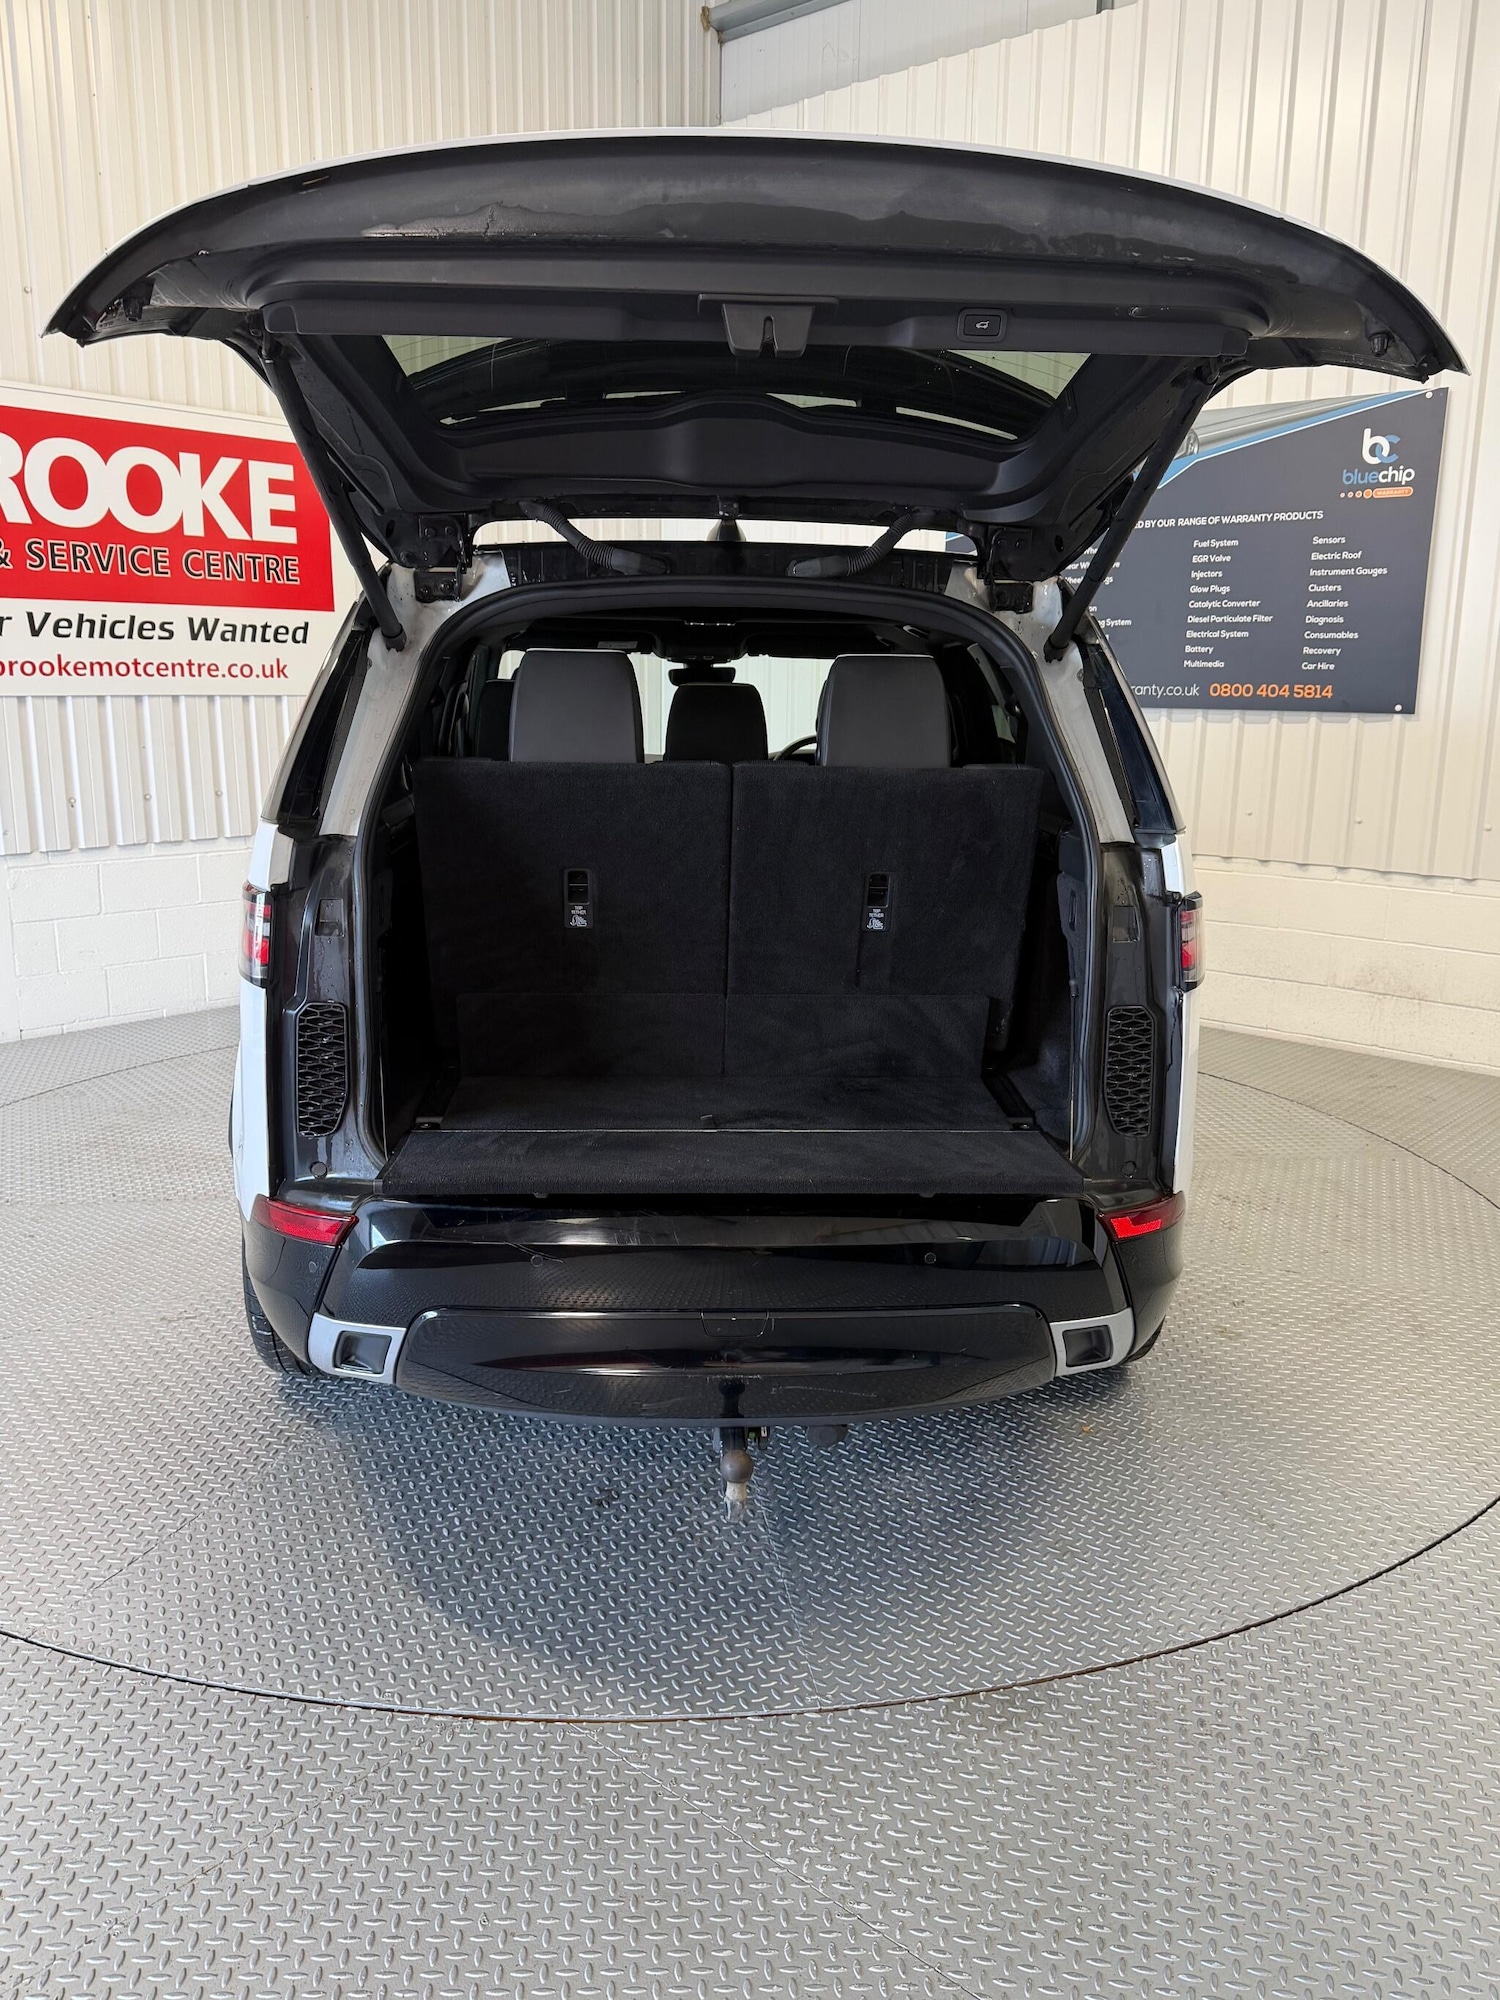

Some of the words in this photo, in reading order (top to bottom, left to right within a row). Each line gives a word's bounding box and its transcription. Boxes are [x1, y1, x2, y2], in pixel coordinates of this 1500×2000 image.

[1342, 465, 1415, 485] bluechip
[1145, 519, 1157, 528] BY
[1157, 518, 1176, 528] OUR
[1178, 517, 1207, 527] RANGE
[1208, 515, 1220, 525] OF
[1222, 513, 1273, 524] WARRANTY
[1273, 511, 1324, 522] PRODUCTS
[1193, 540, 1210, 548] Fuel
[1210, 539, 1239, 549] System
[1312, 536, 1346, 545] Sensors
[1192, 555, 1209, 563] EGR
[1210, 554, 1232, 562] Valve
[1311, 552, 1341, 561] Electric
[1342, 551, 1363, 560] Roof
[25, 538, 171, 577] SERVICE
[182, 549, 300, 585] CENTRE
[1191, 570, 1223, 580] Injectors
[1309, 568, 1354, 577] Instrument
[1355, 566, 1388, 577] Gauges
[1190, 586, 1209, 594] Glow
[1210, 585, 1231, 595] Plugs
[1308, 583, 1342, 592] Clusters
[1189, 601, 1221, 609] Catalytic
[1222, 600, 1261, 608] Converter
[1306, 599, 1349, 608] Ancillaries
[1106, 619, 1132, 627] System
[1187, 615, 1210, 623] Diesel
[1210, 614, 1251, 623] Particulate
[1252, 613, 1273, 622] Filter
[1305, 615, 1345, 626] Diagnosis
[26, 611, 175, 640] Vehicles
[187, 616, 309, 644] Wanted
[1186, 630, 1220, 638] Electrical
[1220, 629, 1249, 639] System
[1304, 631, 1359, 640] Consumables
[1185, 645, 1214, 655] Battery
[1303, 647, 1341, 656] Recovery
[1184, 660, 1225, 668] Multimedia
[1301, 662, 1317, 670] Car
[1317, 661, 1335, 670] Hire
[1209, 683, 1254, 697] 0800
[1256, 684, 1290, 697] 404
[1293, 684, 1333, 698] 5814
